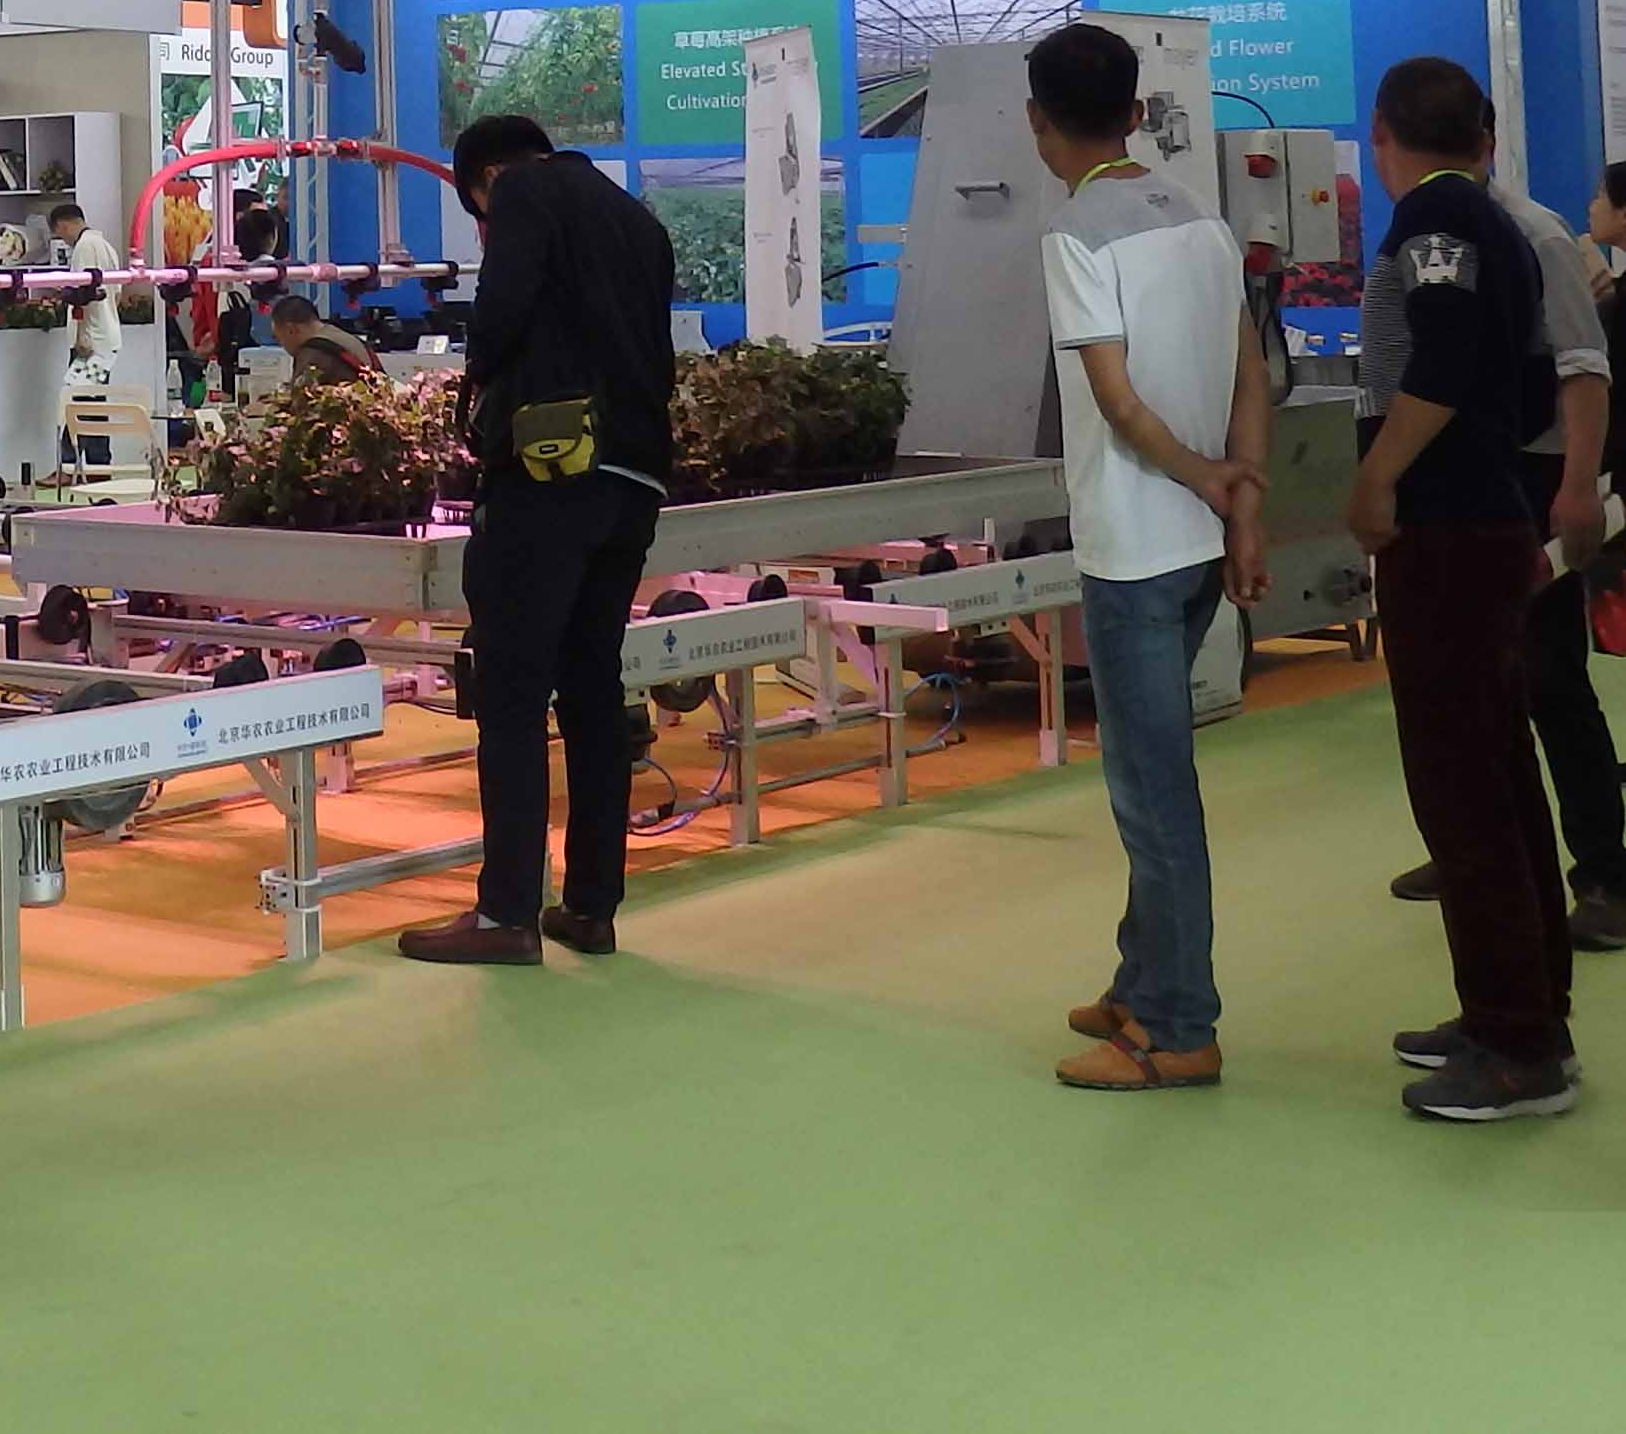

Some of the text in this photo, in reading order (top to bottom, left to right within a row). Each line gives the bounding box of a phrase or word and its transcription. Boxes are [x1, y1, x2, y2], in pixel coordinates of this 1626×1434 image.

[231, 47, 273, 68] Group
[1229, 37, 1295, 57] Flower
[661, 62, 726, 79] Elevated
[1248, 72, 1319, 94] System
[218, 702, 370, 745] 北京华农农业工程技术有限公司
